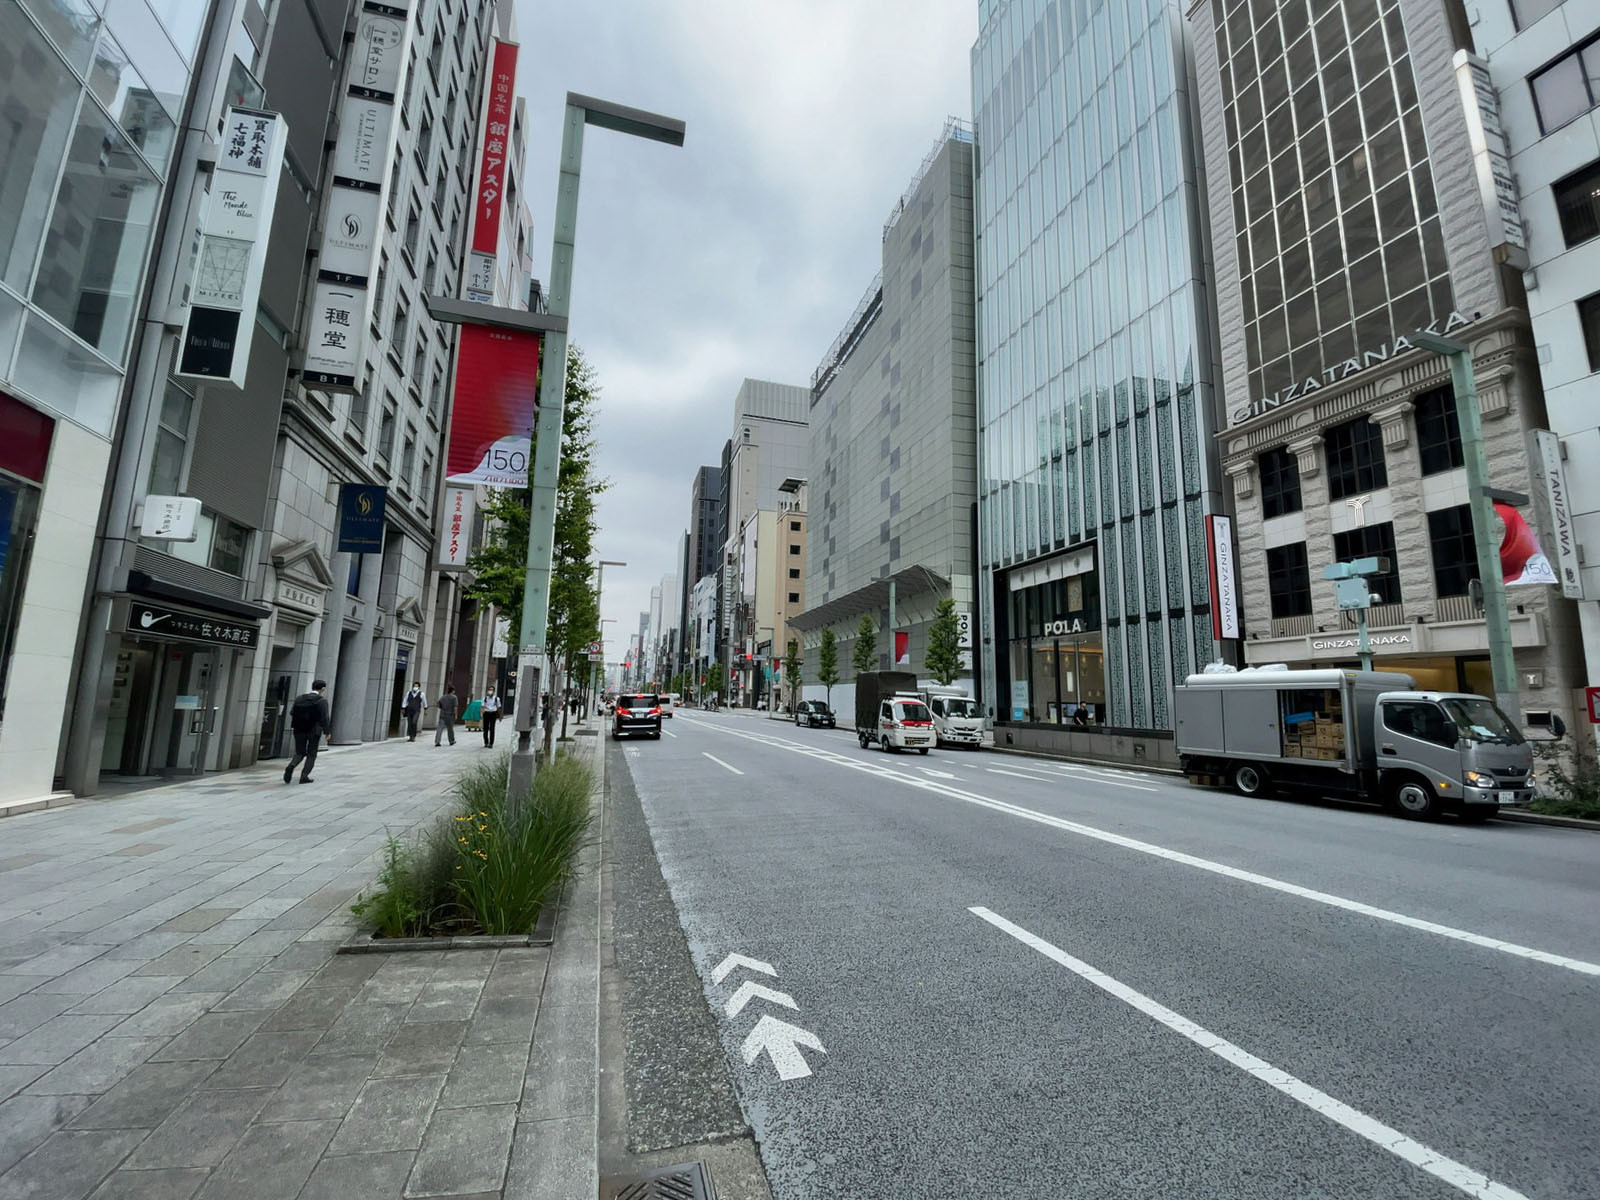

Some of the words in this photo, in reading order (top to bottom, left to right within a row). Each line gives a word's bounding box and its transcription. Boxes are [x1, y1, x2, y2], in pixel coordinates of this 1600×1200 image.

[228, 122, 249, 159] 七福神
[360, 109, 377, 172] ULTIMATE
[482, 121, 508, 220] 銀座アスター
[219, 190, 237, 201] The
[336, 274, 352, 282] 1F
[320, 375, 338, 384] B1
[1550, 470, 1571, 556] TANIZAWA
[449, 514, 462, 563] 銀座アスター
[201, 622, 251, 643] 佐々木商店
[1044, 618, 1082, 636] POLA
[1312, 634, 1410, 650] GINZATNAKA
